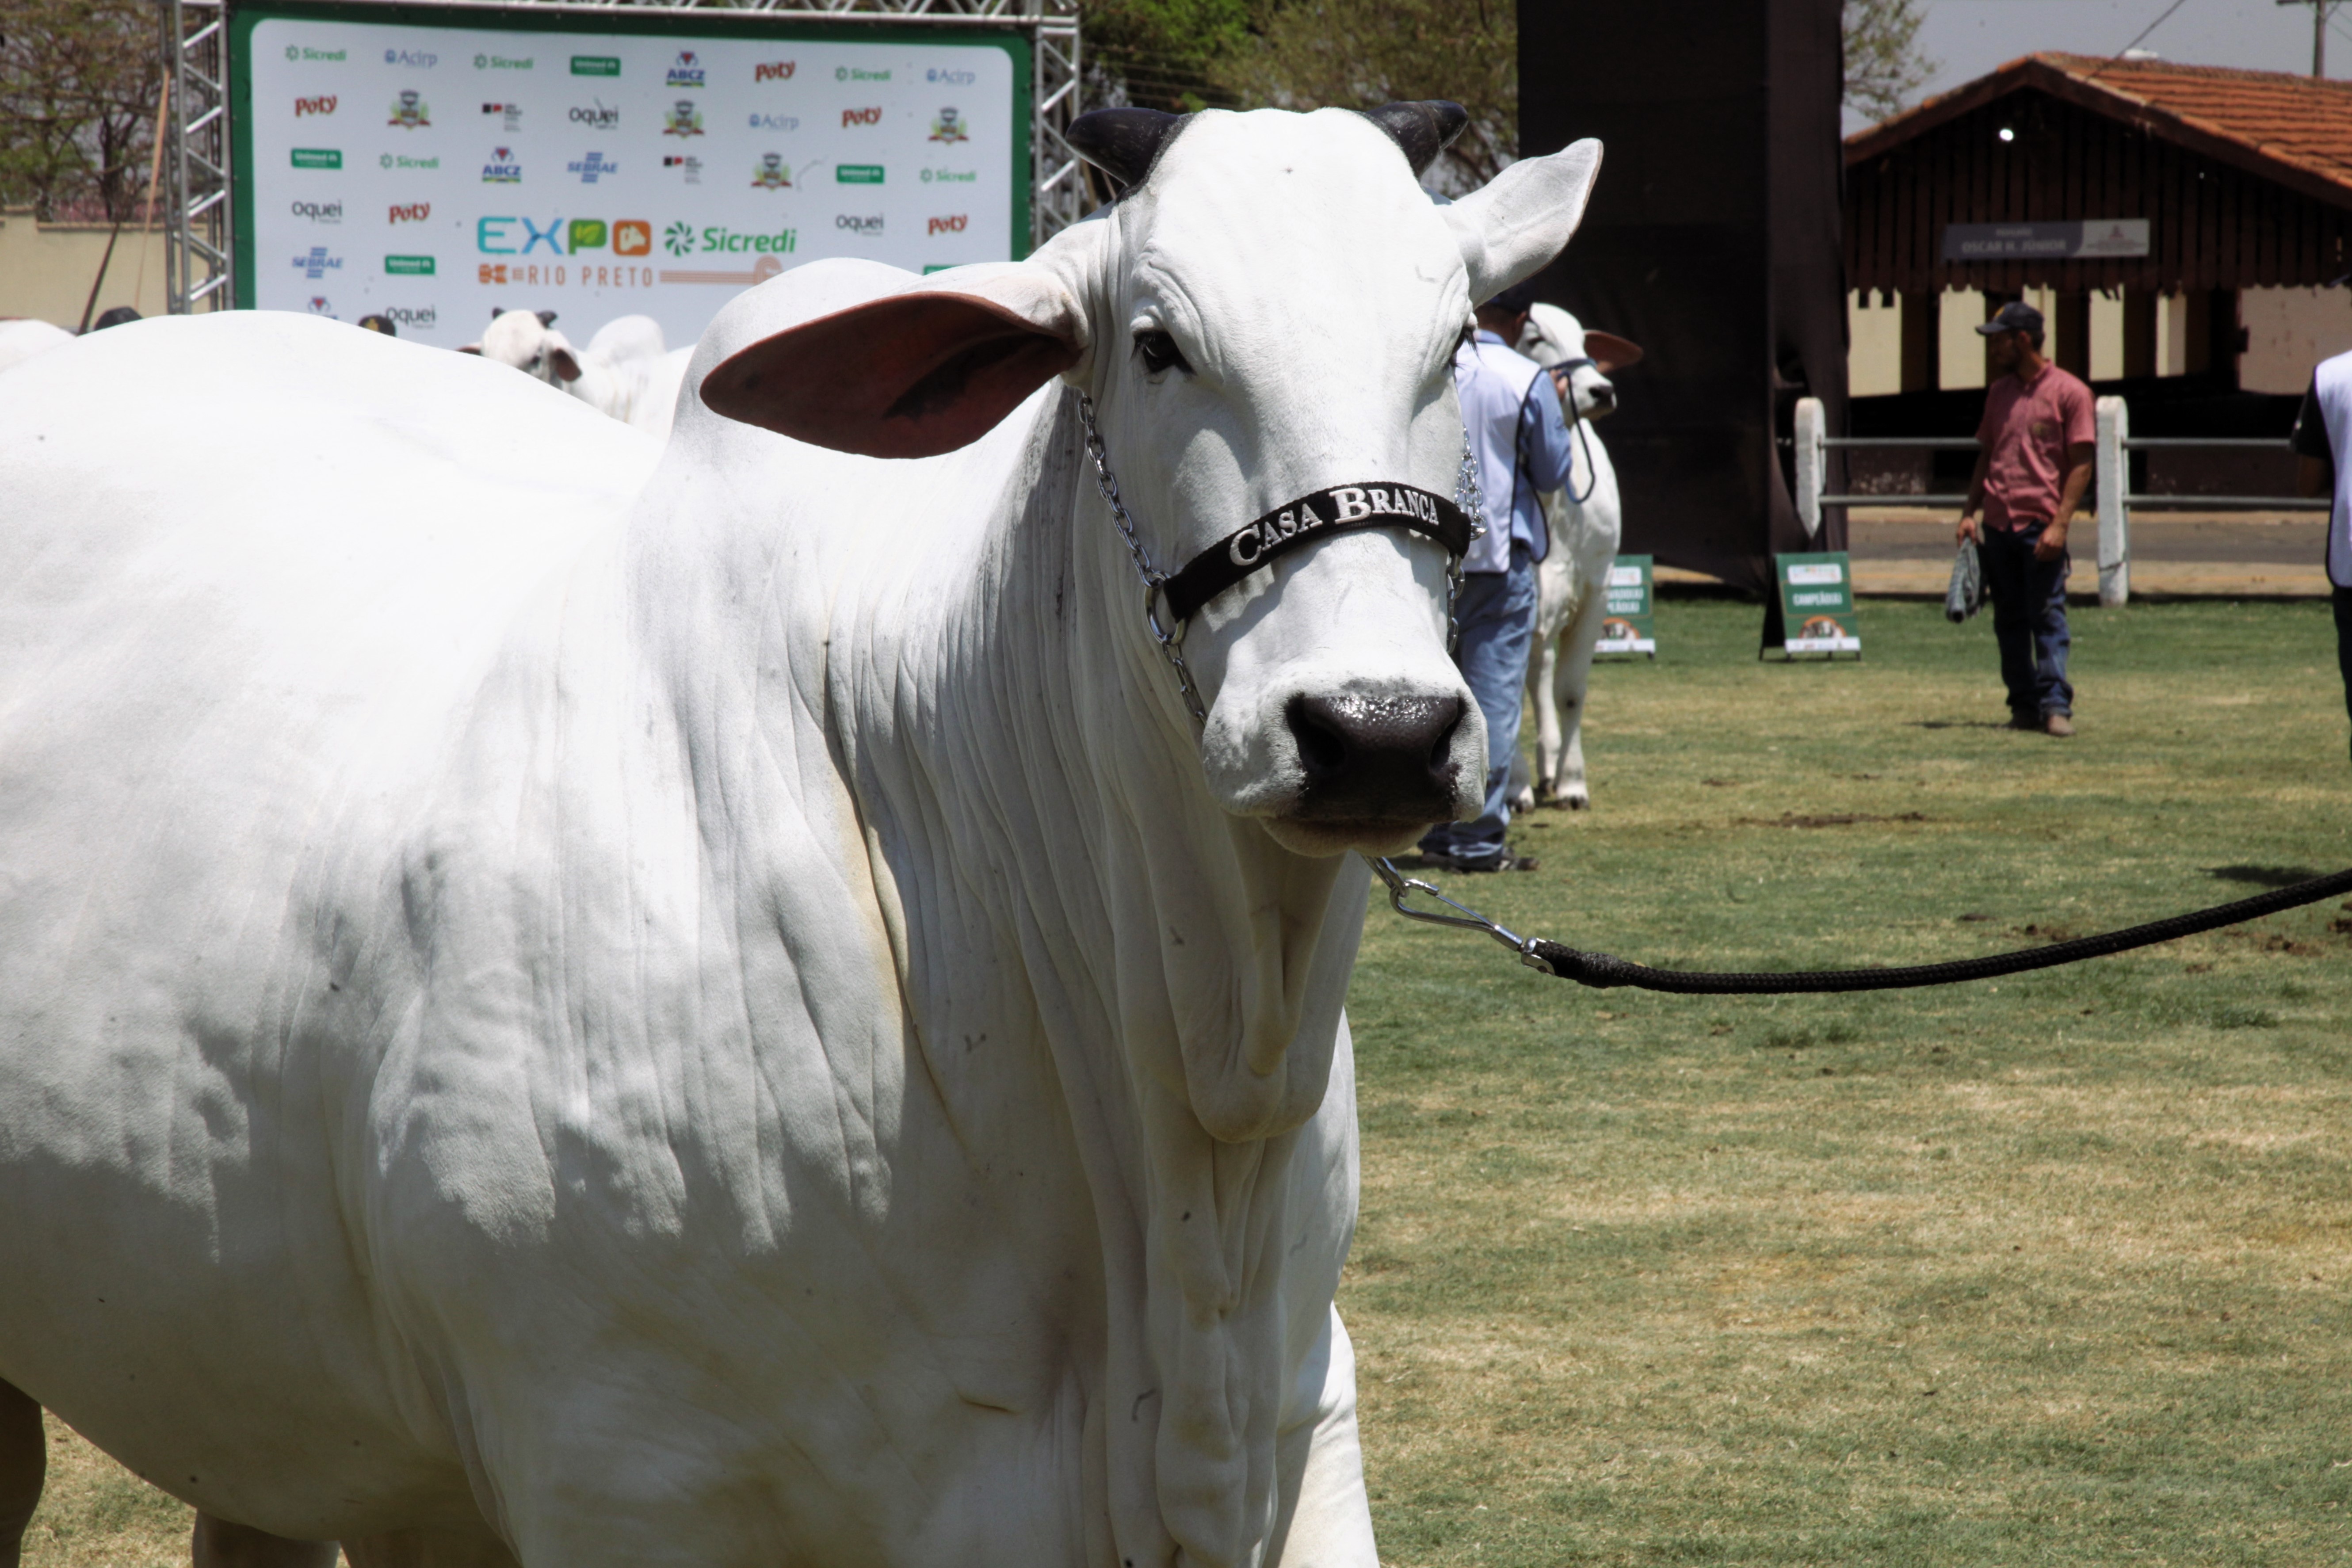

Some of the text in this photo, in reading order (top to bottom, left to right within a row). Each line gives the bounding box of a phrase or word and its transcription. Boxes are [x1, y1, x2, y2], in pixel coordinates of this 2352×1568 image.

[303, 47, 347, 61] Sicredi
[399, 50, 438, 67] Acirp
[491, 55, 534, 69] Sicredi
[667, 69, 705, 80] ABCZ
[755, 61, 796, 83] Poty
[295, 95, 337, 118] Poty
[842, 107, 882, 129] Poty
[397, 156, 439, 169] Sicredi
[482, 165, 521, 175] ABCZ
[291, 200, 342, 221] Oquei
[389, 202, 431, 225] Poty
[835, 212, 884, 231] Oquei
[928, 214, 968, 236] Poty
[477, 217, 652, 256] EXPO
[701, 227, 797, 253] Sicredi
[527, 264, 566, 286] RIO
[581, 265, 653, 287] PRETO
[1229, 487, 1439, 566] CASA BRANCA
